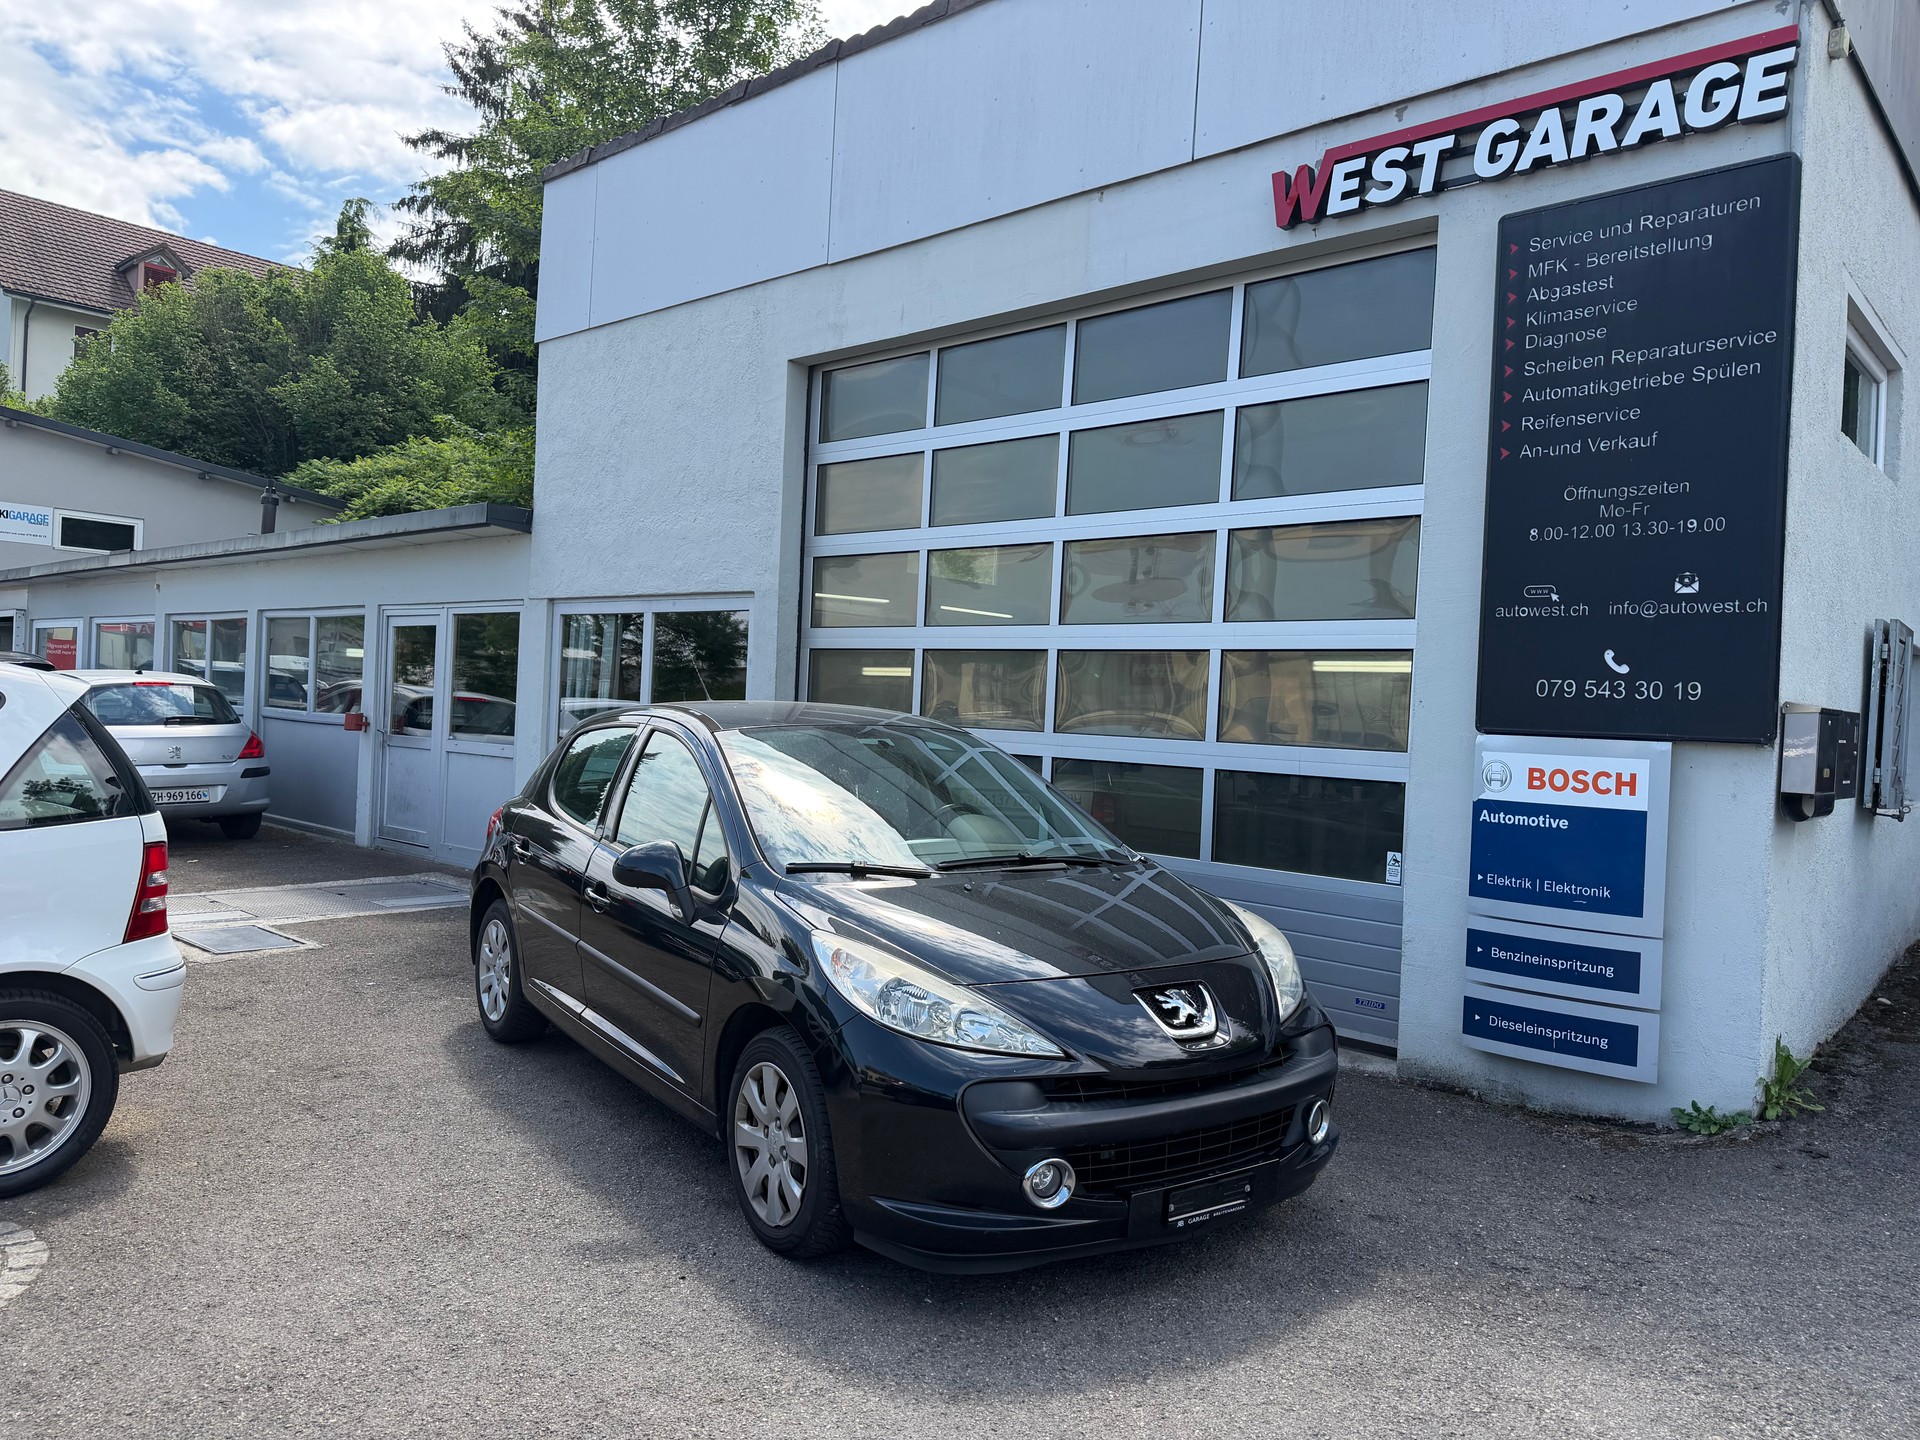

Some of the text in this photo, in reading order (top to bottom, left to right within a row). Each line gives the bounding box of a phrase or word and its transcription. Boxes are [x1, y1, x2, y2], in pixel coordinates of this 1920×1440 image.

[1272, 46, 1797, 229] WEST GARAGE
[1529, 194, 1761, 253] Service und Reparaturen
[1528, 258, 1568, 279] MFK
[1586, 232, 1713, 268] Bereitstellung
[1527, 275, 1614, 303] Abgastest
[1525, 298, 1638, 327] Klimaservice
[1525, 326, 1607, 350] Diagnose
[1523, 328, 1777, 377] Scheiben Reparaturservice
[1522, 360, 1761, 404] Automatikgetriebe Spülen
[1521, 406, 1641, 432] Reifenservice
[1519, 431, 1658, 459] An-und Verkauf
[1563, 480, 1690, 502] Öffnungszeiten
[1599, 502, 1650, 518] Mo-Fr
[1529, 517, 1726, 542] 8.00-12.00 13.30-19.00
[1495, 602, 1589, 618] autowest.ch
[1608, 598, 1768, 619] info@autowest.ch
[1536, 680, 1702, 701] 079 543 30 19
[1527, 767, 1637, 797] BOSCH
[1479, 809, 1569, 830] Automotive
[1487, 873, 1532, 890] Elektrik
[1543, 880, 1611, 899] Elektronik
[1491, 946, 1615, 978] Benzineinspritzung
[1358, 999, 1383, 1009] TRIDO
[1488, 1015, 1609, 1050] Dieseleinspritzung
[1188, 1214, 1210, 1224] GARAGE
